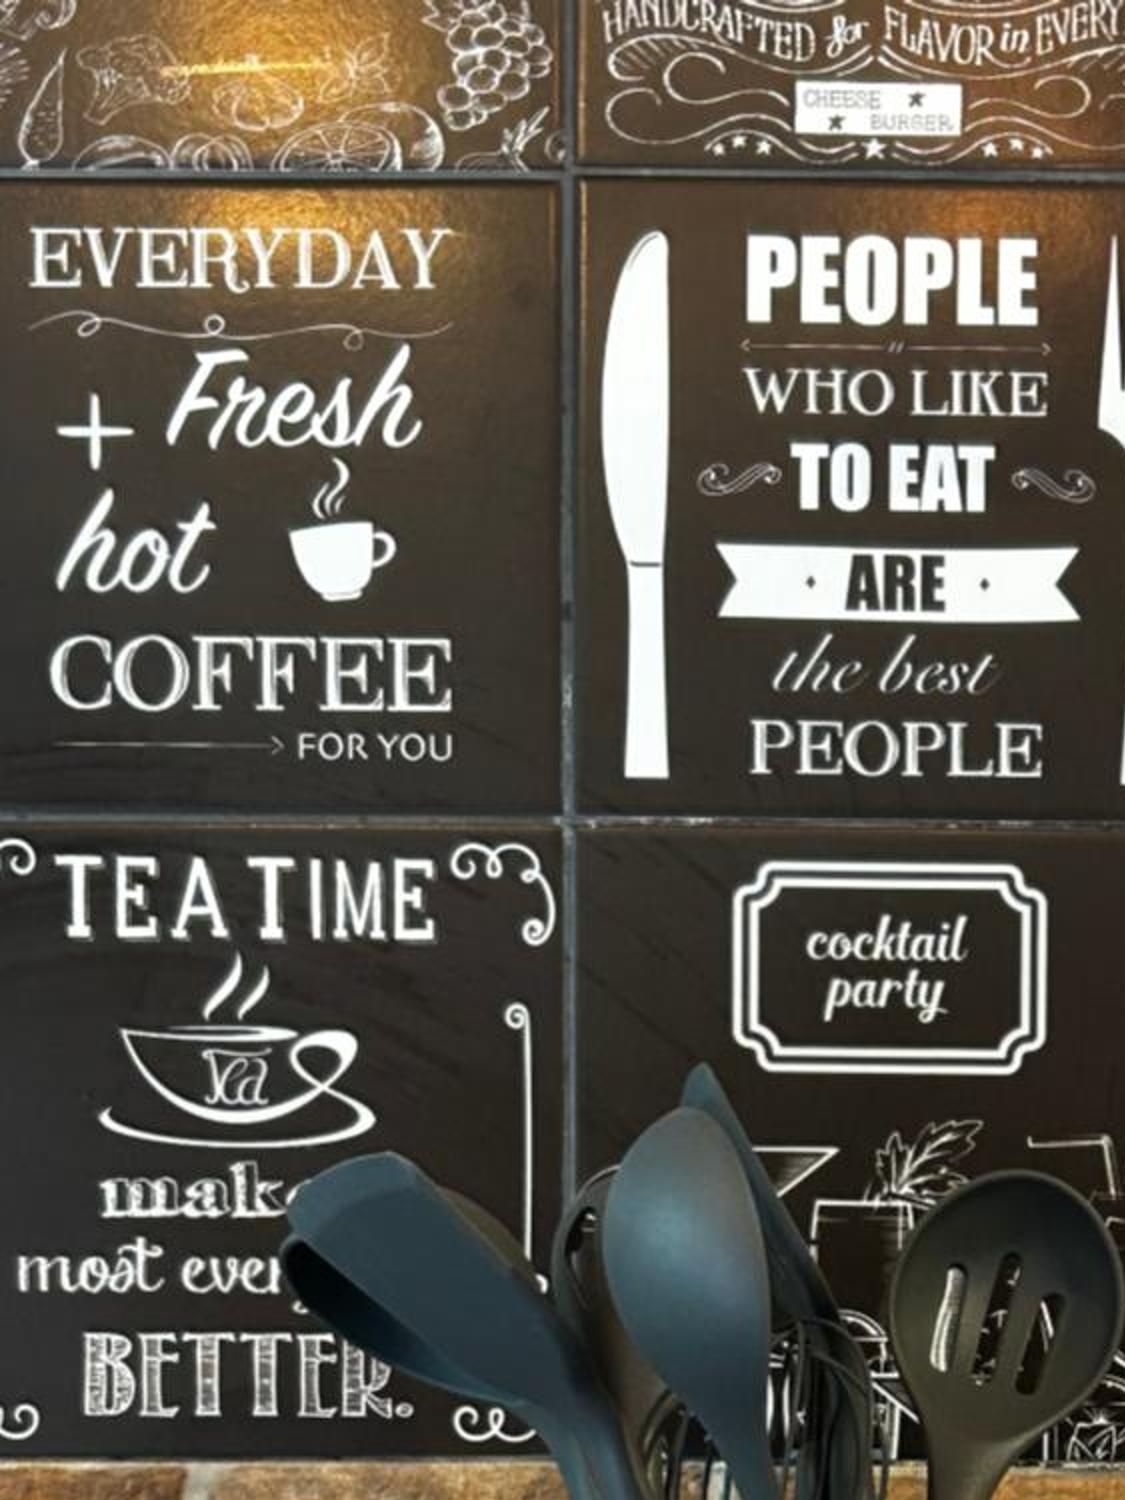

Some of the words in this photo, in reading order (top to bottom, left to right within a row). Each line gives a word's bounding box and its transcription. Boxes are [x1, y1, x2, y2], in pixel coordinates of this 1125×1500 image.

[601, 0, 816, 62] HANDCRAFTED
[824, 14, 870, 58] for
[883, 5, 1012, 67] FLAVOR
[1000, 22, 1030, 53] in
[1036, 0, 1124, 55] EVERY
[803, 89, 881, 110] CHEESE
[28, 226, 451, 293] EVERYDAY
[745, 233, 1040, 327] PEOPLE
[165, 342, 424, 451] Fresh
[742, 366, 896, 417] WHO
[910, 368, 1049, 418] LIKE
[789, 441, 872, 514] TO
[887, 443, 997, 514] EAT
[55, 487, 218, 594] hot
[843, 554, 947, 614] ARE
[48, 633, 453, 714] COFFEE
[771, 632, 863, 694] the
[877, 633, 994, 695] best
[296, 730, 370, 762] FOR
[376, 731, 454, 763] YOU
[749, 718, 1044, 779] PEOPLE
[805, 913, 969, 963] cocktail
[822, 967, 948, 1025] party
[98, 1158, 308, 1219] mak
[16, 1235, 166, 1295] most
